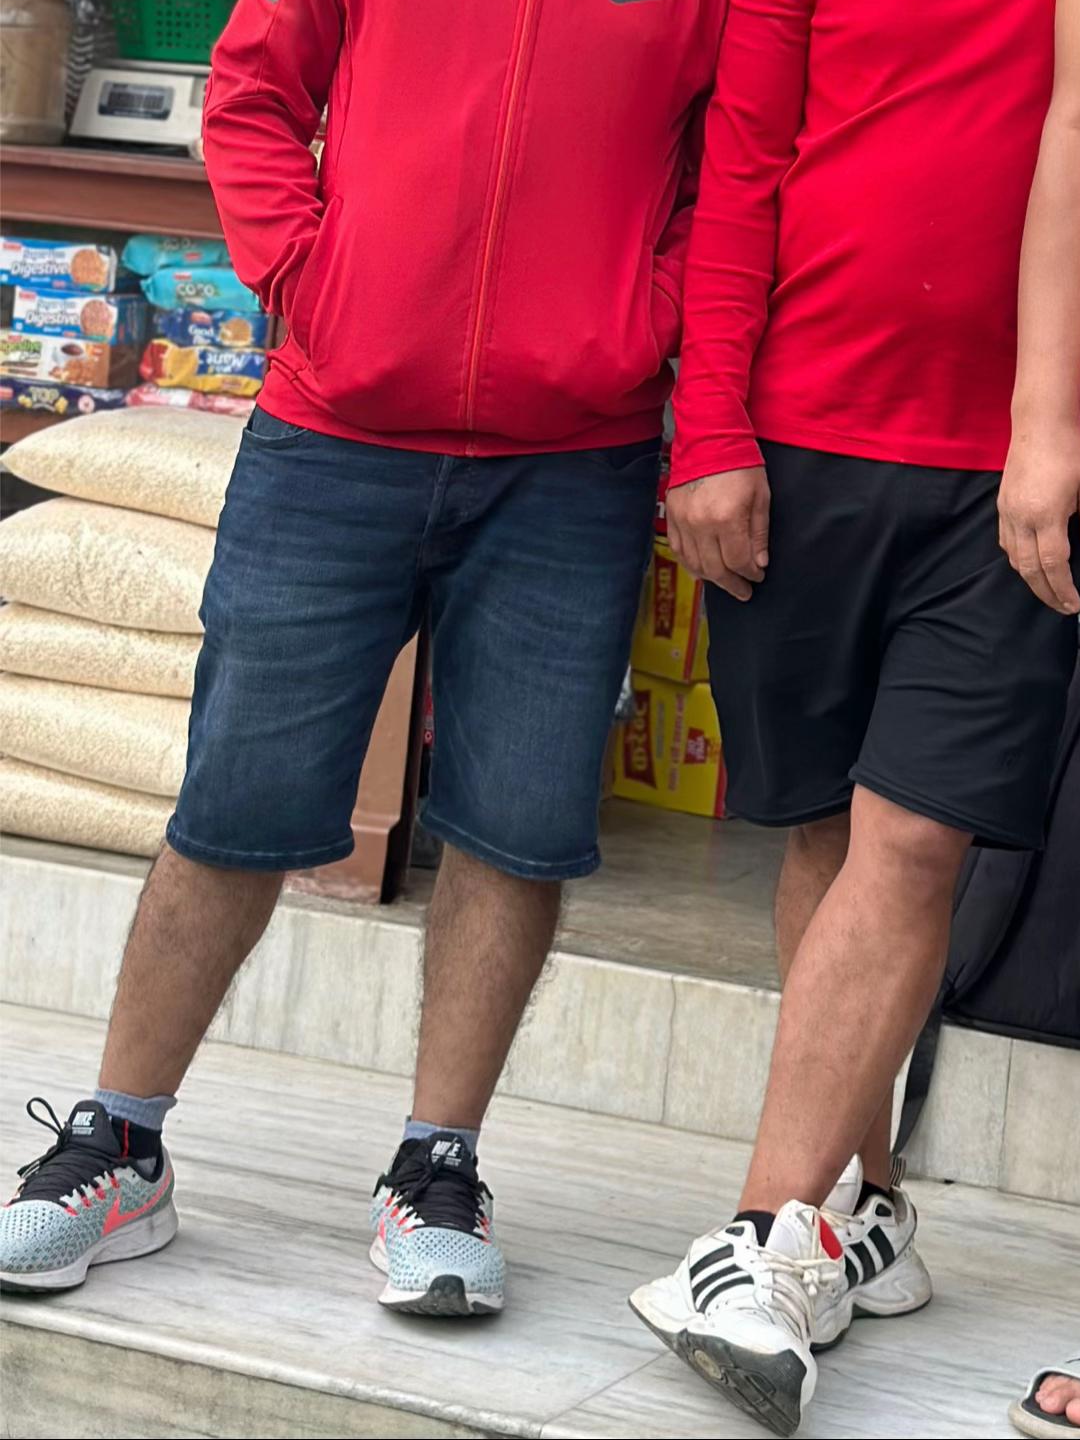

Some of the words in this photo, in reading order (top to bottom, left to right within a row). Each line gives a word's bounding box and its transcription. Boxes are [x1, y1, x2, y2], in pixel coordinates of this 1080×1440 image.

[10, 260, 70, 279] Digestive
[25, 309, 81, 328] Digestive
[29, 386, 59, 402] TOP
[72, 1111, 96, 1126] NIKE
